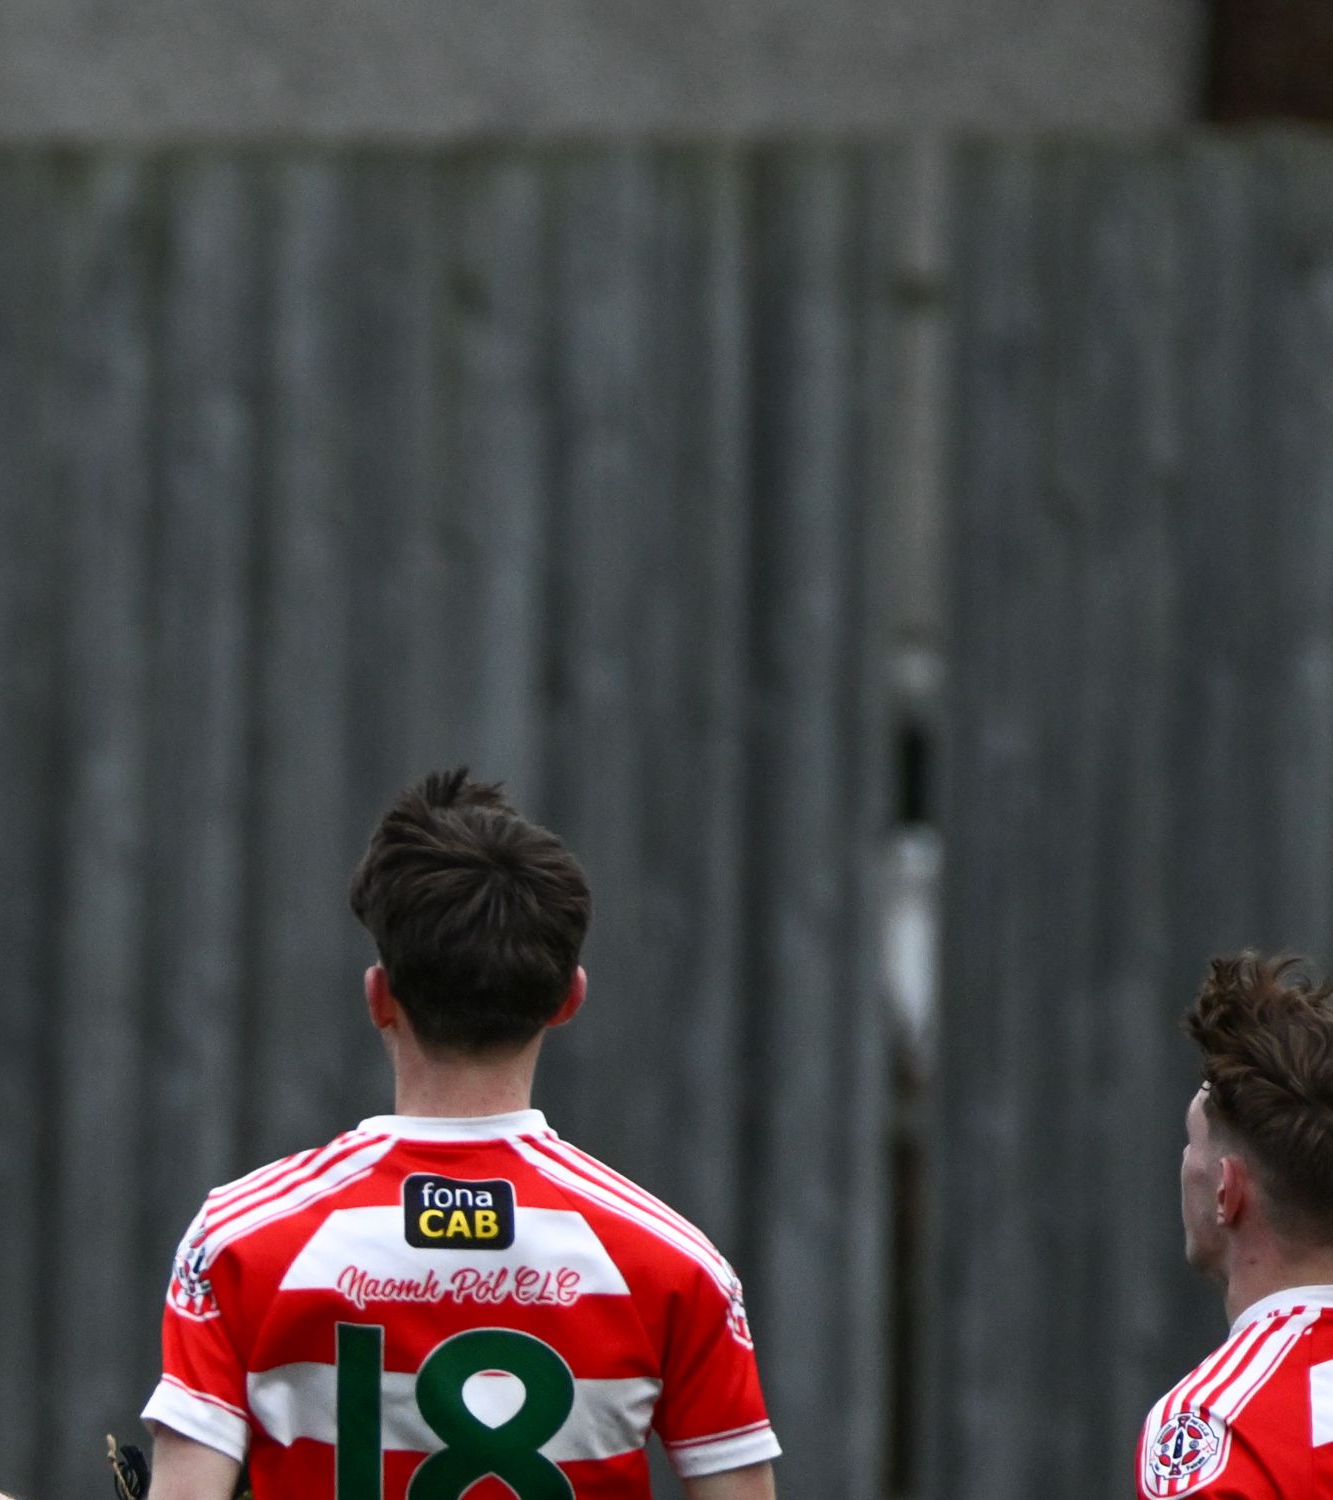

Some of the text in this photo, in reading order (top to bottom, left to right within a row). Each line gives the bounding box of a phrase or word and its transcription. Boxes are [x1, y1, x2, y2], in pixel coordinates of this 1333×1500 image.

[422, 1182, 493, 1208] fona
[419, 1209, 500, 1240] CAB
[336, 1265, 442, 1311] Naomh
[450, 1267, 510, 1304] Pól
